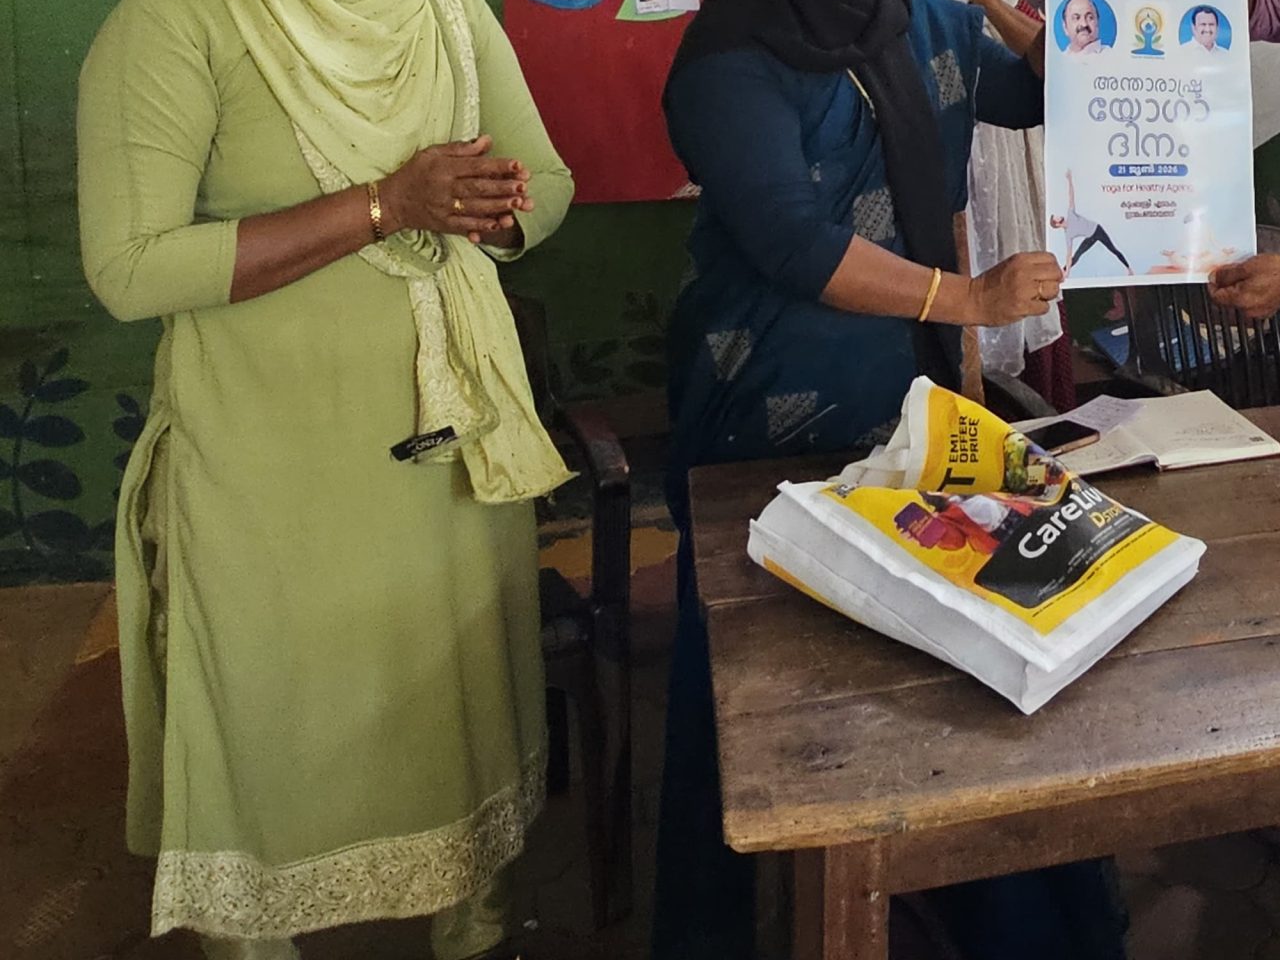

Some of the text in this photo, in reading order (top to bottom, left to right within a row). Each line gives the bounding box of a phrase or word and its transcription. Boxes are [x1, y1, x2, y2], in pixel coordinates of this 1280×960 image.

[1108, 121, 1190, 158] ദിനം
[1118, 166, 1126, 174] 21
[1101, 184, 1121, 194] Yoga
[1123, 184, 1134, 192] for
[1136, 184, 1165, 193] Healthy
[949, 434, 959, 463] EMI
[959, 416, 969, 463] OFFER
[969, 418, 980, 463] PRICE
